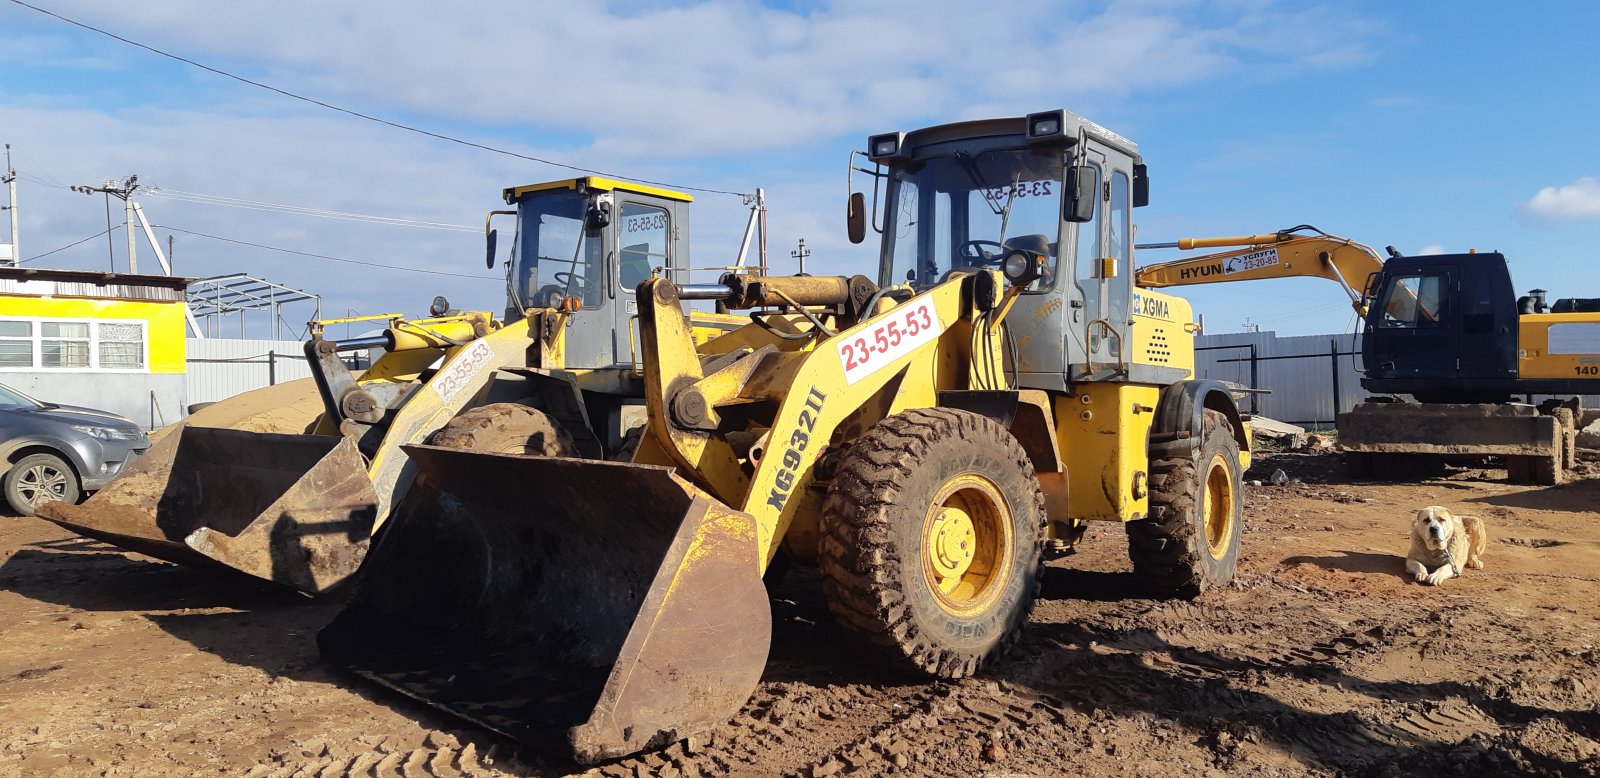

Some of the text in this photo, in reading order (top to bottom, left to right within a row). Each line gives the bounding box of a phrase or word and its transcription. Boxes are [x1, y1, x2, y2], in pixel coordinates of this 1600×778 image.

[1243, 249, 1276, 261] УСЛУГИ
[1243, 255, 1278, 270] 23-20-85
[1180, 263, 1225, 279] HYUN
[1142, 296, 1170, 319] XGMA
[841, 305, 932, 372] 23-55-53
[438, 343, 489, 396] 23-55-53
[1574, 366, 1599, 376] 140
[767, 385, 827, 513] XG932II
